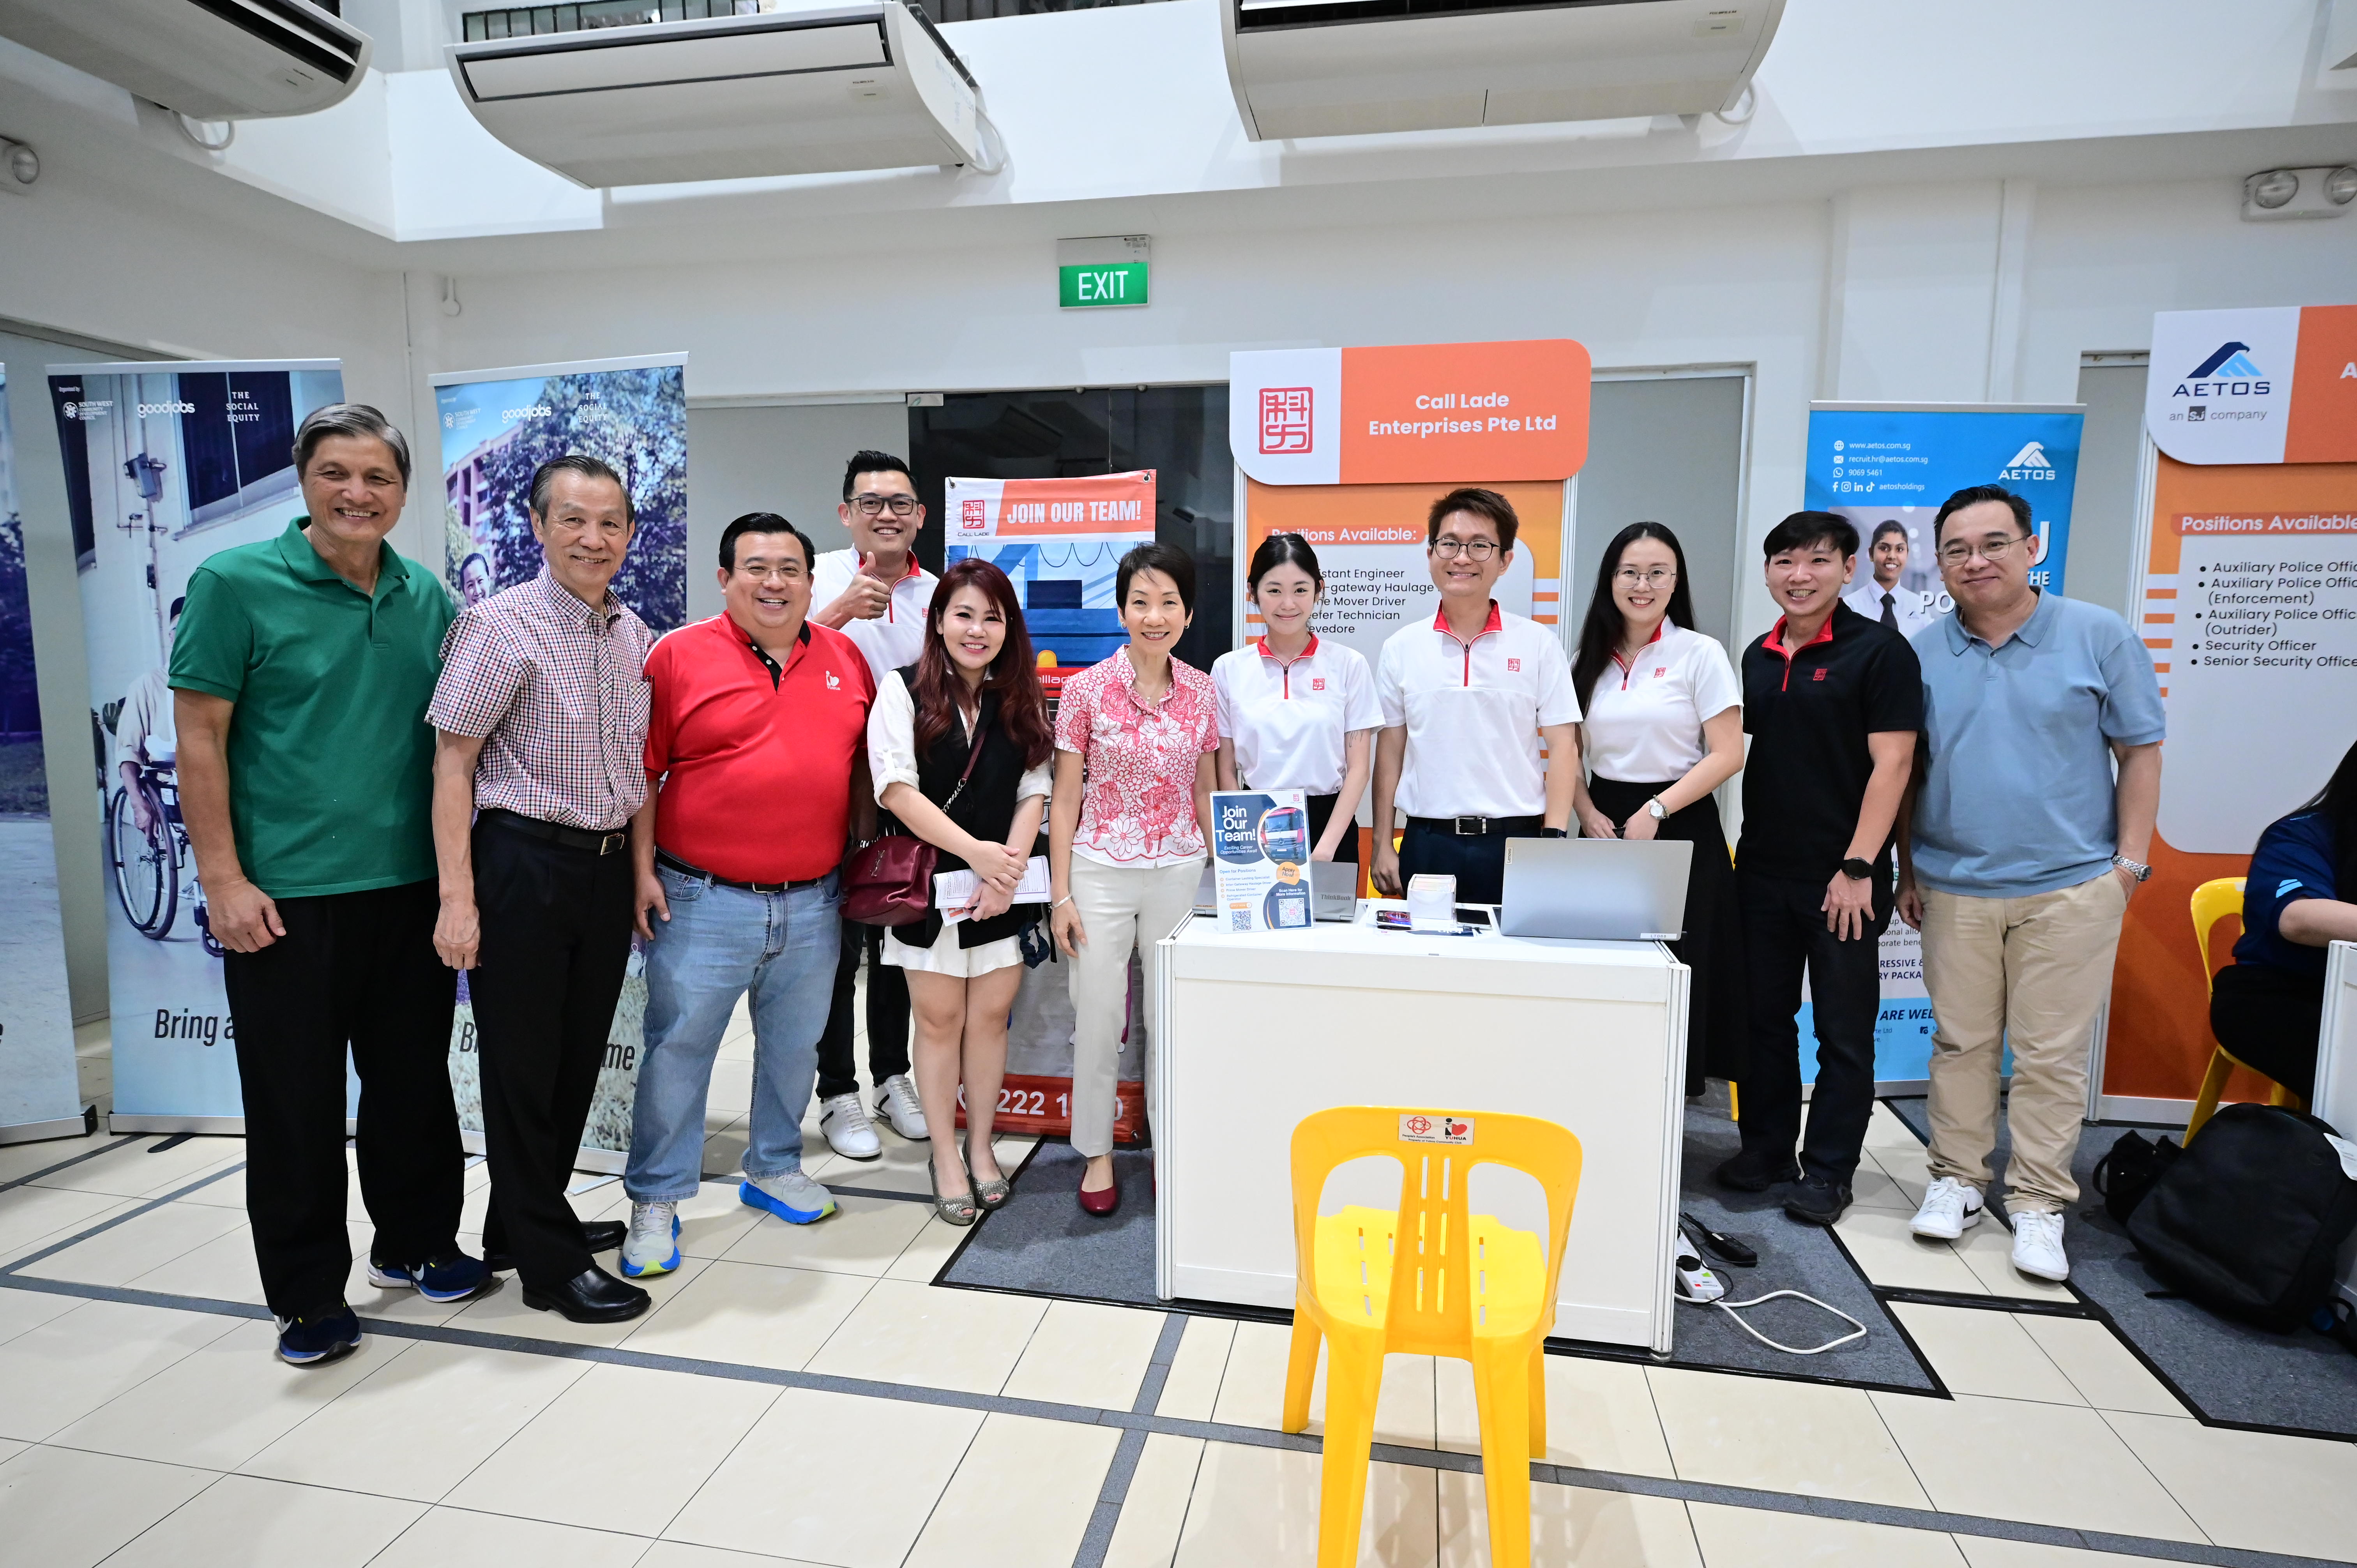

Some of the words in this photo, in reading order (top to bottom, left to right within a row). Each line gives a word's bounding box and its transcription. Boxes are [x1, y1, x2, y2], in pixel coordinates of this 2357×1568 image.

[1078, 271, 1128, 300] EXIT
[2173, 381, 2270, 397] AETOS
[579, 403, 607, 411] SOCIAL
[1415, 392, 1455, 410] Call
[1460, 392, 1510, 409] Lade
[137, 400, 195, 418] goodjobs
[502, 404, 551, 424] goodjobs
[227, 414, 260, 423] EQUITY
[579, 414, 607, 424] EQUITY
[2170, 412, 2184, 421] an
[2210, 410, 2267, 426] company
[1369, 418, 1482, 438] Enterprises
[1488, 417, 1520, 433] Pte
[1525, 415, 1557, 431] Ltd
[1849, 441, 1911, 451] www.aetos.com.sg
[1849, 456, 1928, 464] recruit.hr@aetos.com.sg
[1998, 470, 2055, 480] AETOS
[1879, 483, 1925, 491] aetosholdings
[1007, 504, 1045, 523] JOIN
[1051, 503, 1084, 522] OUR
[1089, 500, 1141, 521] TEAM!
[2182, 516, 2263, 531] Positions
[1339, 527, 1416, 541] Available:
[1354, 569, 1405, 581] Engineer
[2213, 562, 2275, 575] Auxiliary
[2280, 562, 2323, 572] Police
[1325, 583, 1381, 595] -gateway
[1385, 583, 1434, 595] Haulage
[2211, 578, 2273, 591] Auxiliary
[2278, 577, 2321, 588] Police
[1334, 597, 1369, 606] Mover
[1372, 597, 1406, 606] Driver
[2209, 591, 2315, 606] (Enforcement)
[1338, 611, 1400, 620] Technician
[2209, 609, 2270, 622] Auxiliary
[2275, 609, 2318, 620] Police
[2322, 609, 2357, 620] Offic
[2205, 622, 2277, 637] (Outrider)
[2205, 641, 2264, 653] Security
[2269, 640, 2317, 651] Officer
[2204, 656, 2249, 666] Senior
[2254, 656, 2312, 669] Security
[1222, 805, 1247, 818] Join
[1223, 817, 1247, 830] Our
[1216, 828, 1256, 842] Team!
[1880, 1010, 1905, 1021] ARE
[154, 1008, 219, 1047] Bring
[997, 1089, 1044, 1115] 222
